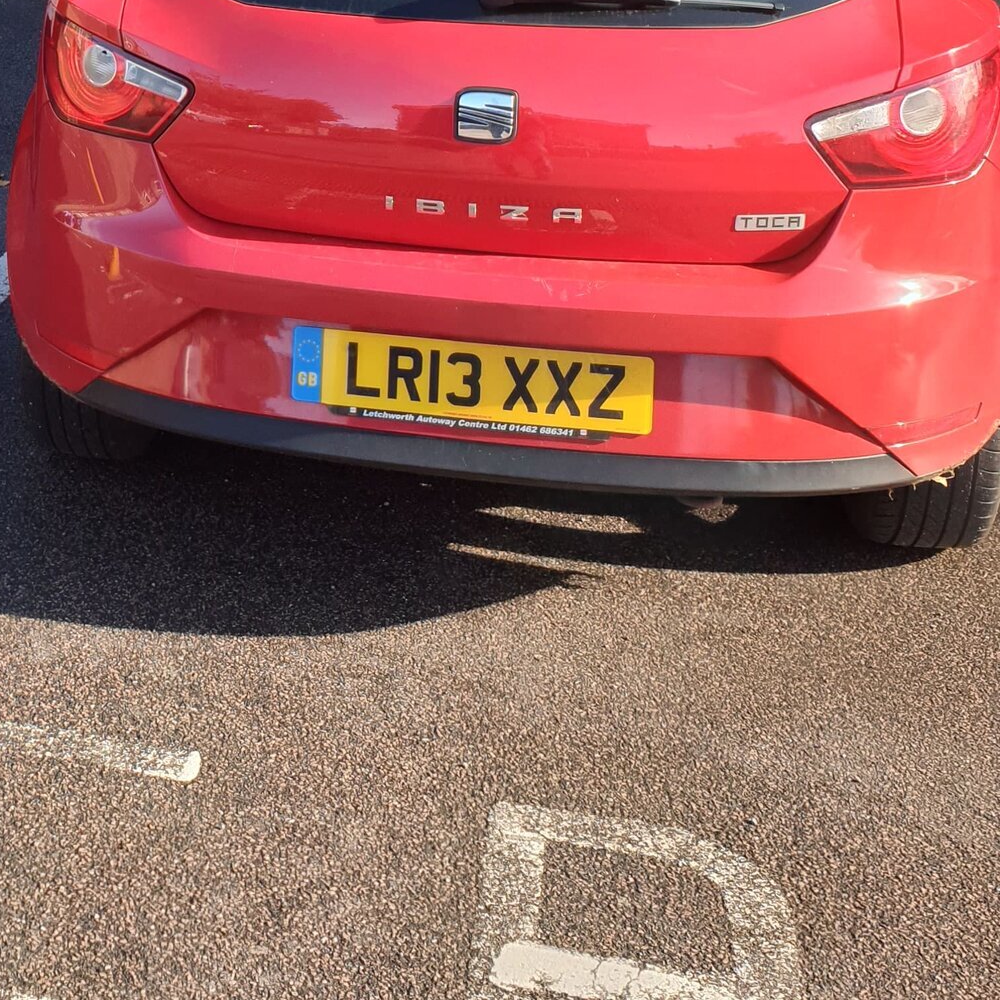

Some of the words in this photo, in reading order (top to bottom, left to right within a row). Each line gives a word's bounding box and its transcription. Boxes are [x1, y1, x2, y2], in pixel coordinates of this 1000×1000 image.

[385, 195, 583, 224] IBIZA
[740, 216, 802, 229] TOCA
[297, 371, 317, 387] GB
[346, 341, 482, 408] LR13
[503, 356, 626, 420] XXZ
[363, 410, 414, 421] Letchworth
[416, 415, 457, 427] Autoway
[458, 420, 489, 430] Centre
[491, 422, 506, 431] Ltd
